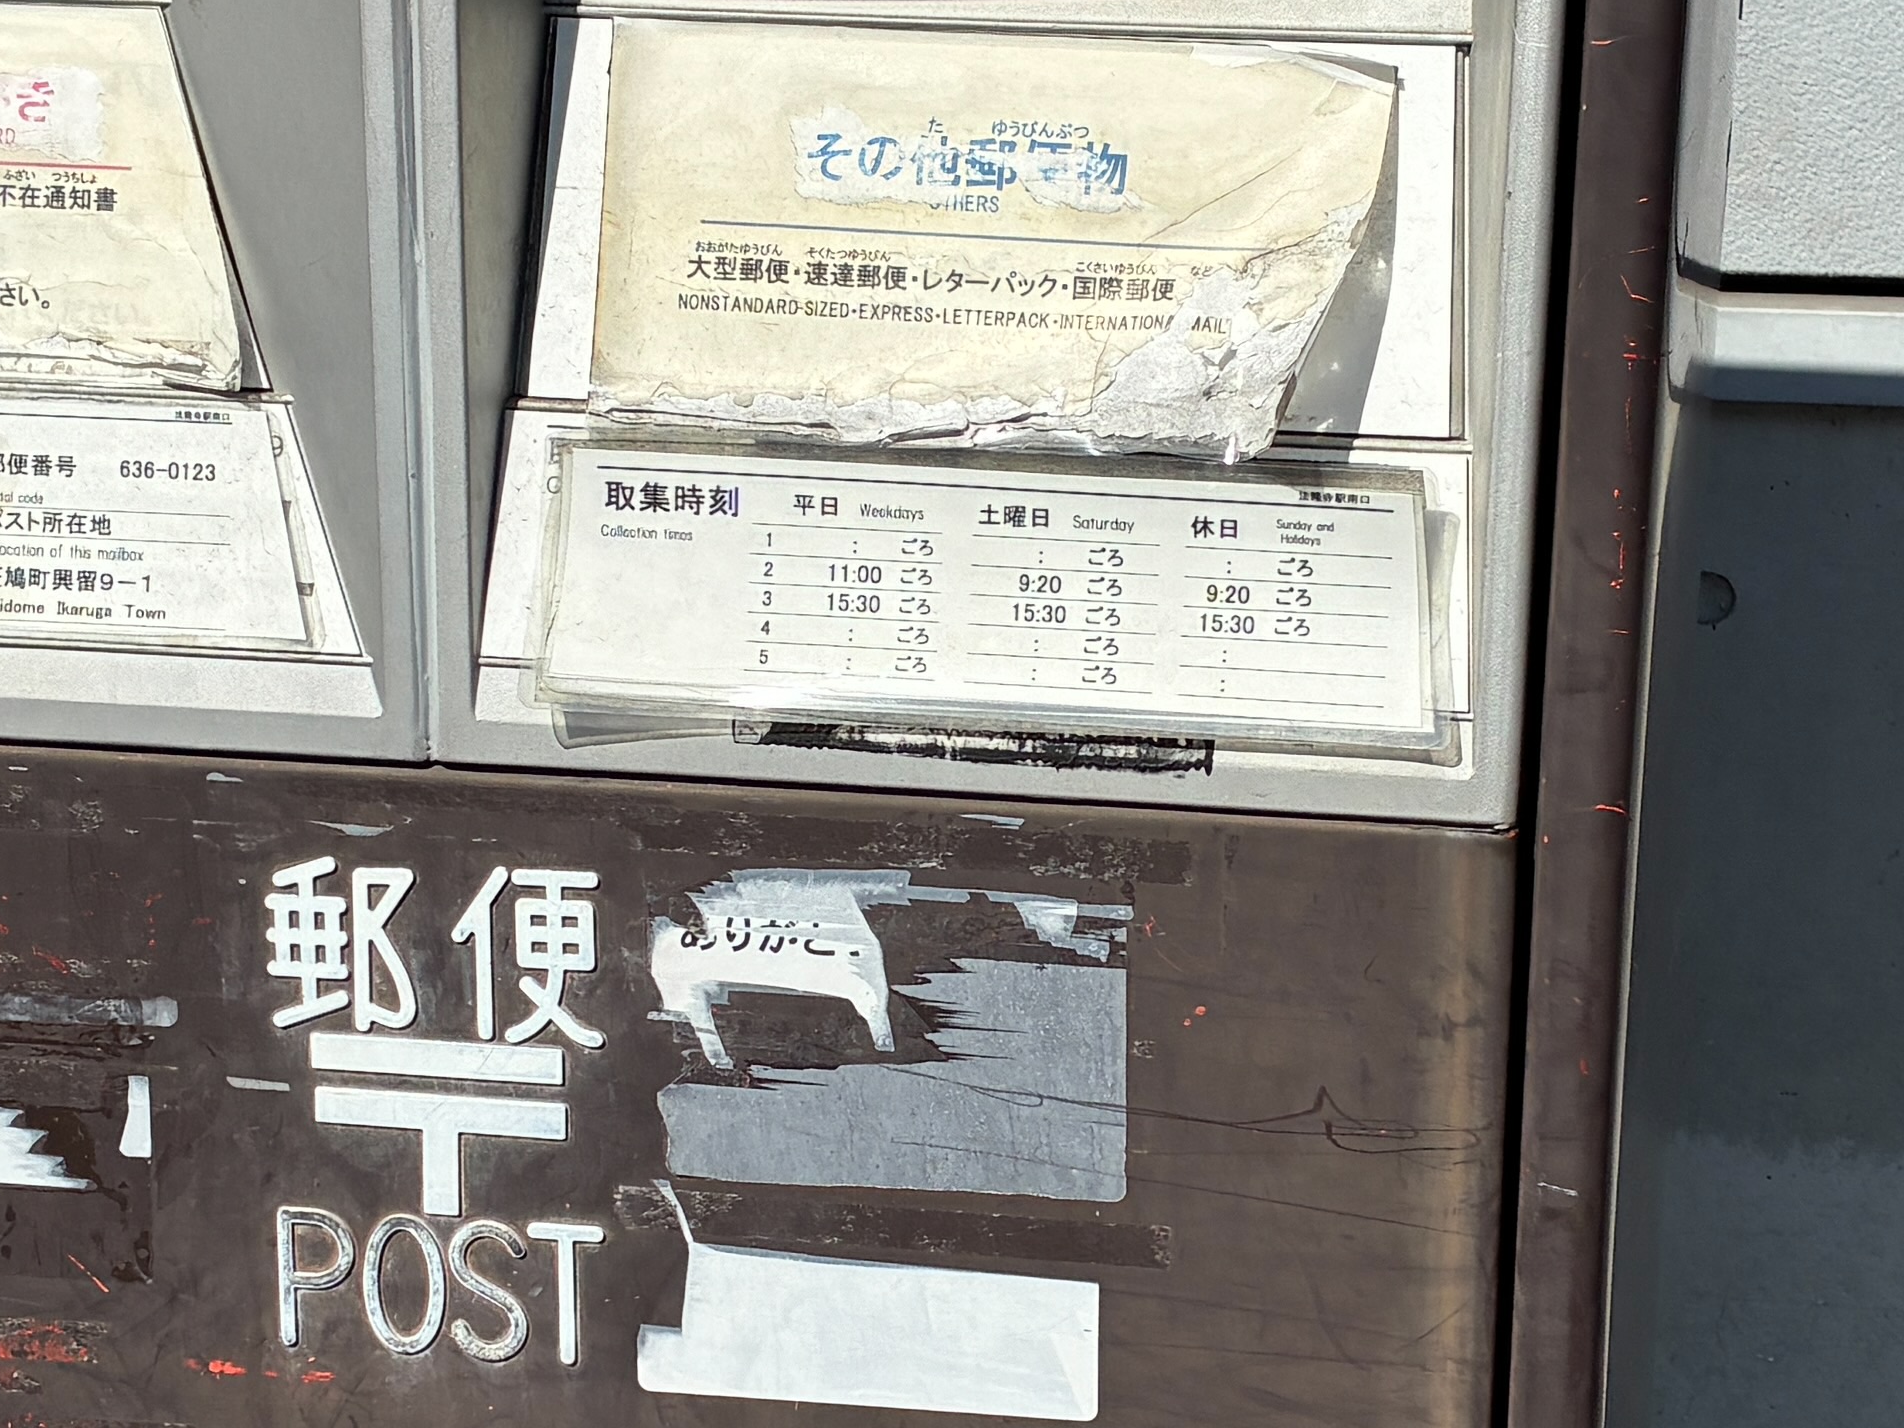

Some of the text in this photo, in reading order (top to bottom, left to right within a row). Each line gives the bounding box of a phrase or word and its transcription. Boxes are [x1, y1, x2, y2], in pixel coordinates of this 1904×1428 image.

[119, 460, 217, 482] 636-0123
[604, 480, 741, 517] 取集時刻
[793, 495, 926, 523] 平日 Weekdays
[600, 524, 658, 540] Collection
[978, 504, 1135, 534] 土曜日 Saturday
[1191, 516, 1239, 540] 休日
[1275, 518, 1335, 533] Sunday and
[49, 542, 63, 558] of
[69, 543, 92, 560] this
[96, 546, 145, 562] mailbox
[766, 532, 773, 547] 1
[901, 536, 934, 557] ごろ
[1088, 546, 1124, 568] ごろ
[1276, 556, 1315, 577] ごろ
[1280, 533, 1322, 548] Holidays
[763, 562, 1313, 607] 2 11:00 ごろ 9:20 ごろ 9:20 ごろ
[56, 600, 113, 620] Ikaruga
[125, 604, 167, 620] Town
[762, 591, 1311, 637] 3 15:30 ごろ 15:30 ごろ 15:30 ごろ
[760, 620, 771, 636] 4
[896, 625, 930, 645] ごろ
[1083, 635, 1120, 657] ごろ
[758, 649, 769, 664] 5
[894, 654, 928, 674] ごろ
[1081, 664, 1118, 685] ごろ
[264, 856, 607, 1049] 郵便
[277, 1206, 606, 1368] POST
